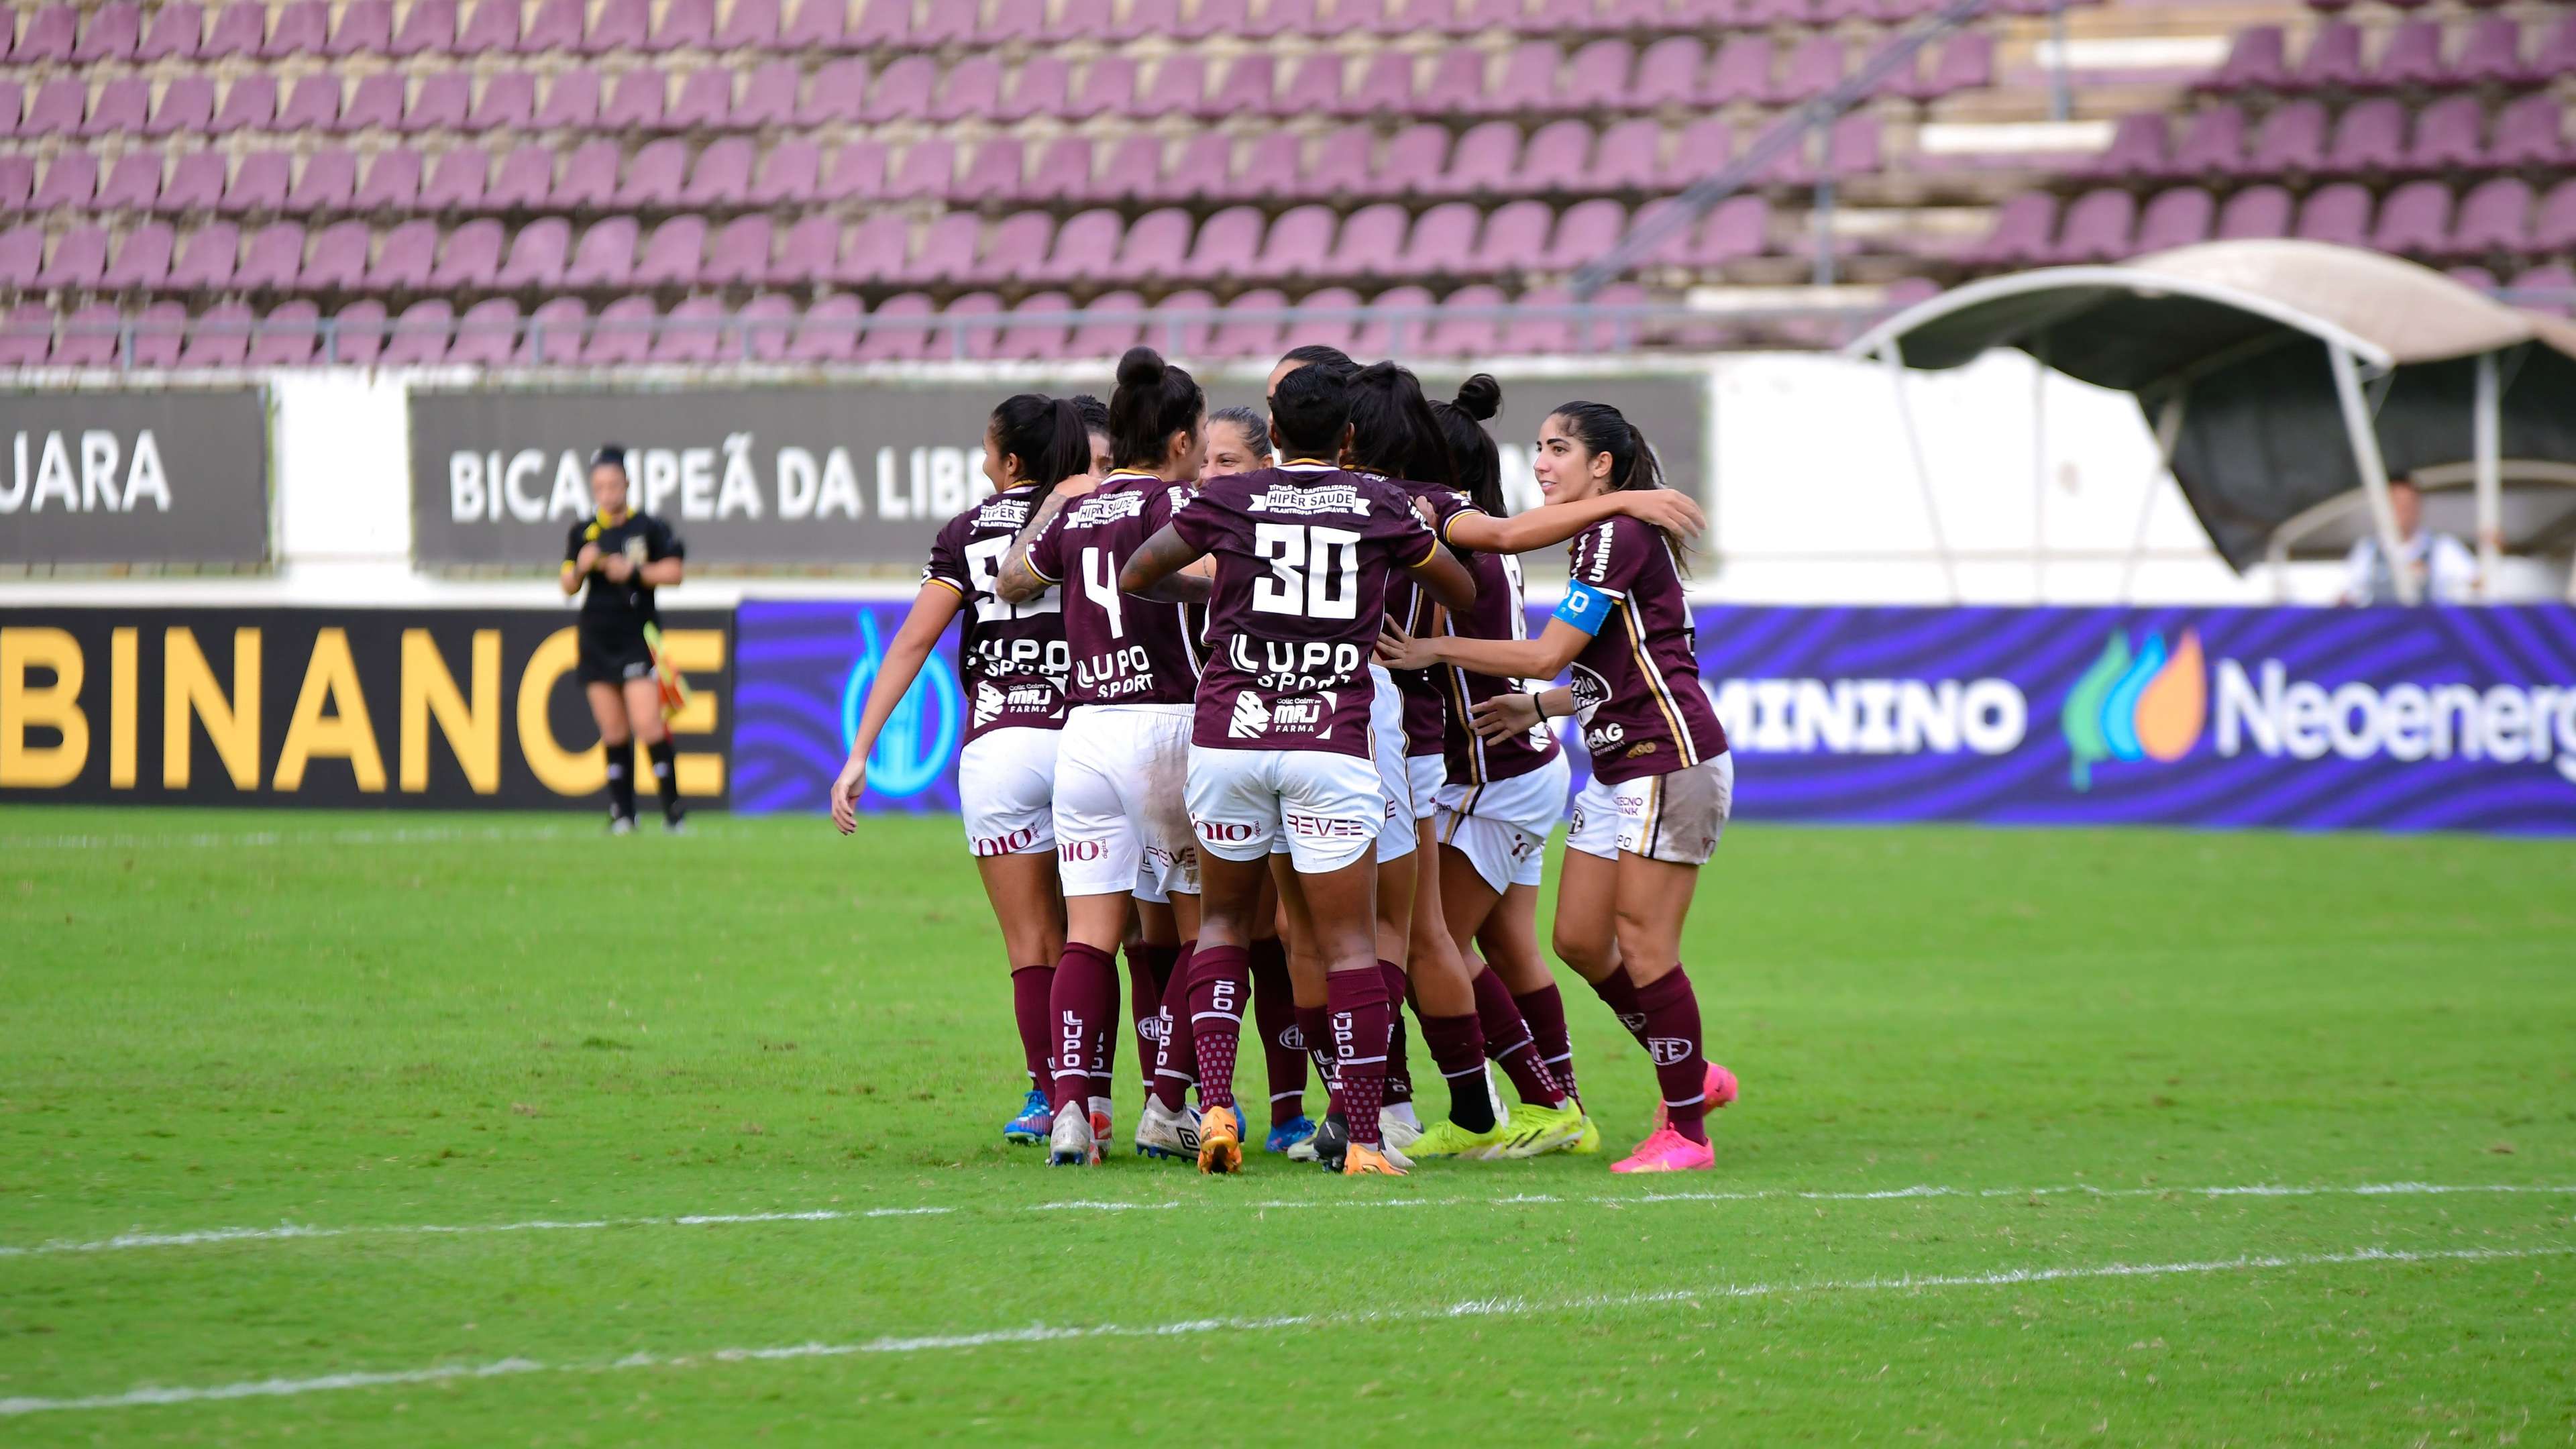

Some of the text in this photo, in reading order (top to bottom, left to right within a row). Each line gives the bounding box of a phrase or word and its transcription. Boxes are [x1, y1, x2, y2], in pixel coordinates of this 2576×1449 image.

[777, 447, 863, 519] DA
[1269, 493, 1305, 507] HIPER
[1252, 523, 1360, 619] 30
[1082, 547, 1124, 639] 4
[1077, 645, 1150, 688] LUPO
[1230, 634, 1359, 674] LUPO
[1007, 689, 1052, 705] MRJ
[1097, 674, 1153, 698] SPORT
[0, 626, 724, 797] BINANCE
[1010, 705, 1048, 713] FARMA
[1273, 704, 1320, 724] MRJ
[1063, 1010, 1082, 1067] LUPO
[1157, 1006, 1174, 1067] LUPO
